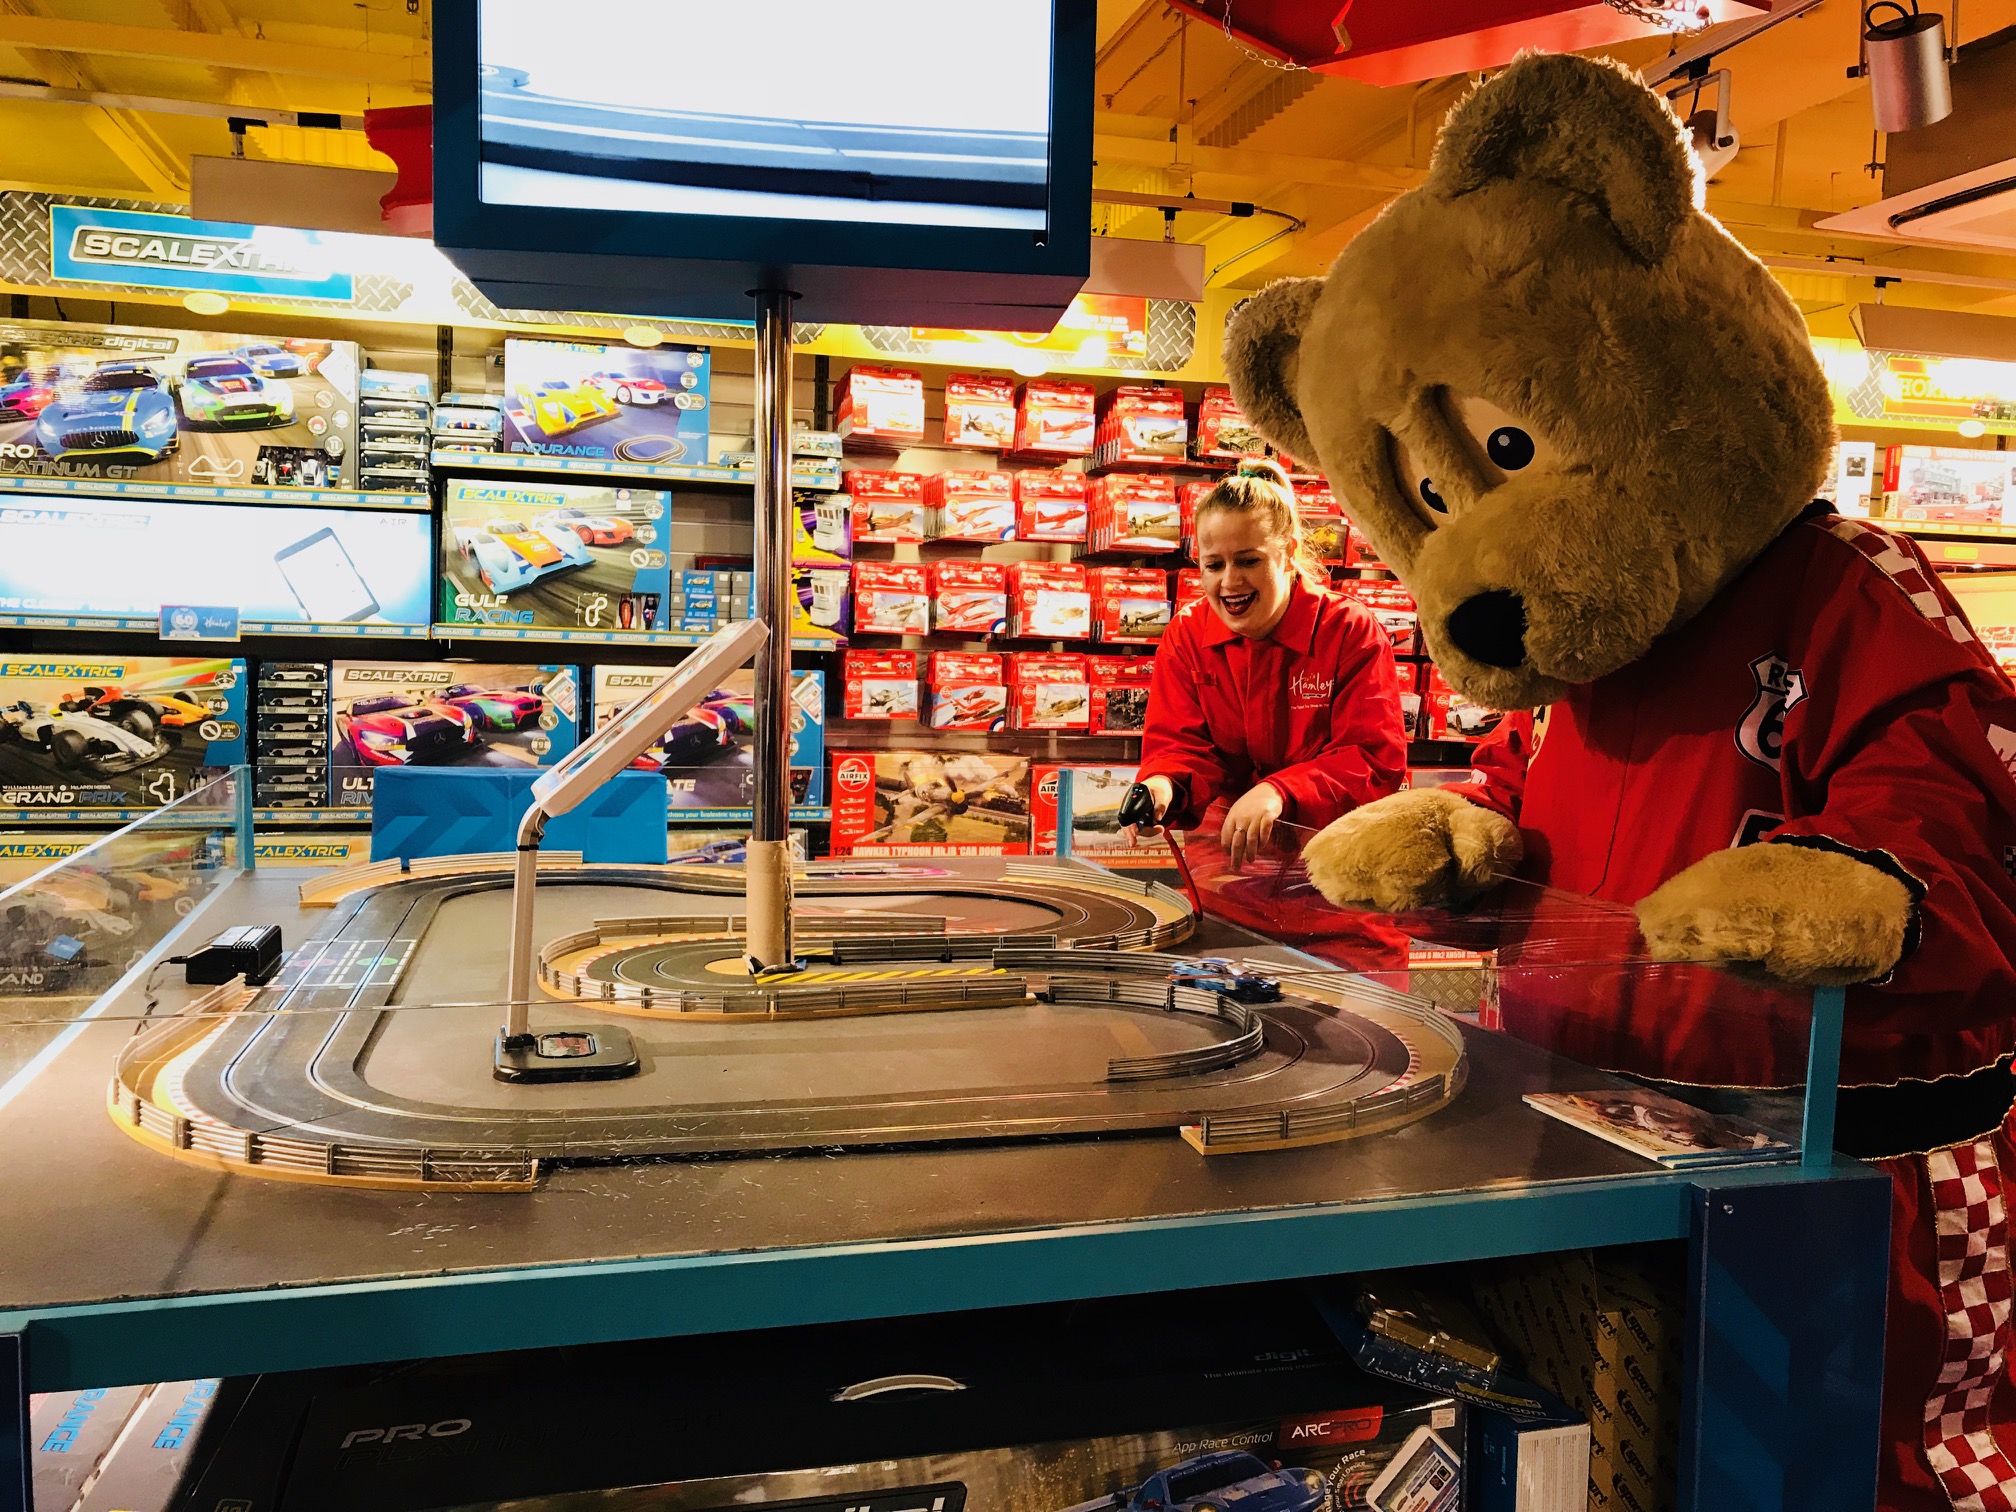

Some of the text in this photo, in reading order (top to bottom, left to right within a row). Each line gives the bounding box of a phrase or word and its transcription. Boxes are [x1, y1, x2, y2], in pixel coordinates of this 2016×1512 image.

[84, 234, 314, 273] SCALEXTR
[105, 337, 172, 350] digital
[511, 442, 605, 457] ENDURANCE
[107, 465, 138, 478] GT
[463, 490, 563, 503] SCALEXTRIC
[455, 594, 508, 607] GULF
[455, 608, 534, 624] RACING
[6, 664, 120, 679] SCALEXTRIC
[347, 670, 450, 683] SCALEXTRIC
[1289, 669, 1334, 698] Hamley
[839, 772, 868, 780] AIRFIX
[342, 777, 374, 790] ULT
[3, 792, 126, 804] GRAND PRIX
[834, 847, 851, 856] 1:24
[853, 846, 890, 856] HAWKER
[892, 846, 931, 856] TYPHOON
[1375, 1366, 1547, 1417] www.scalextric.com
[339, 1418, 472, 1449] PRO
[1172, 1443, 1196, 1454] App
[1200, 1439, 1228, 1450] Race
[1232, 1432, 1273, 1447] Control
[1291, 1421, 1331, 1438] ARC
[1326, 1463, 1342, 1487] your
[1342, 1449, 1366, 1464] Race
